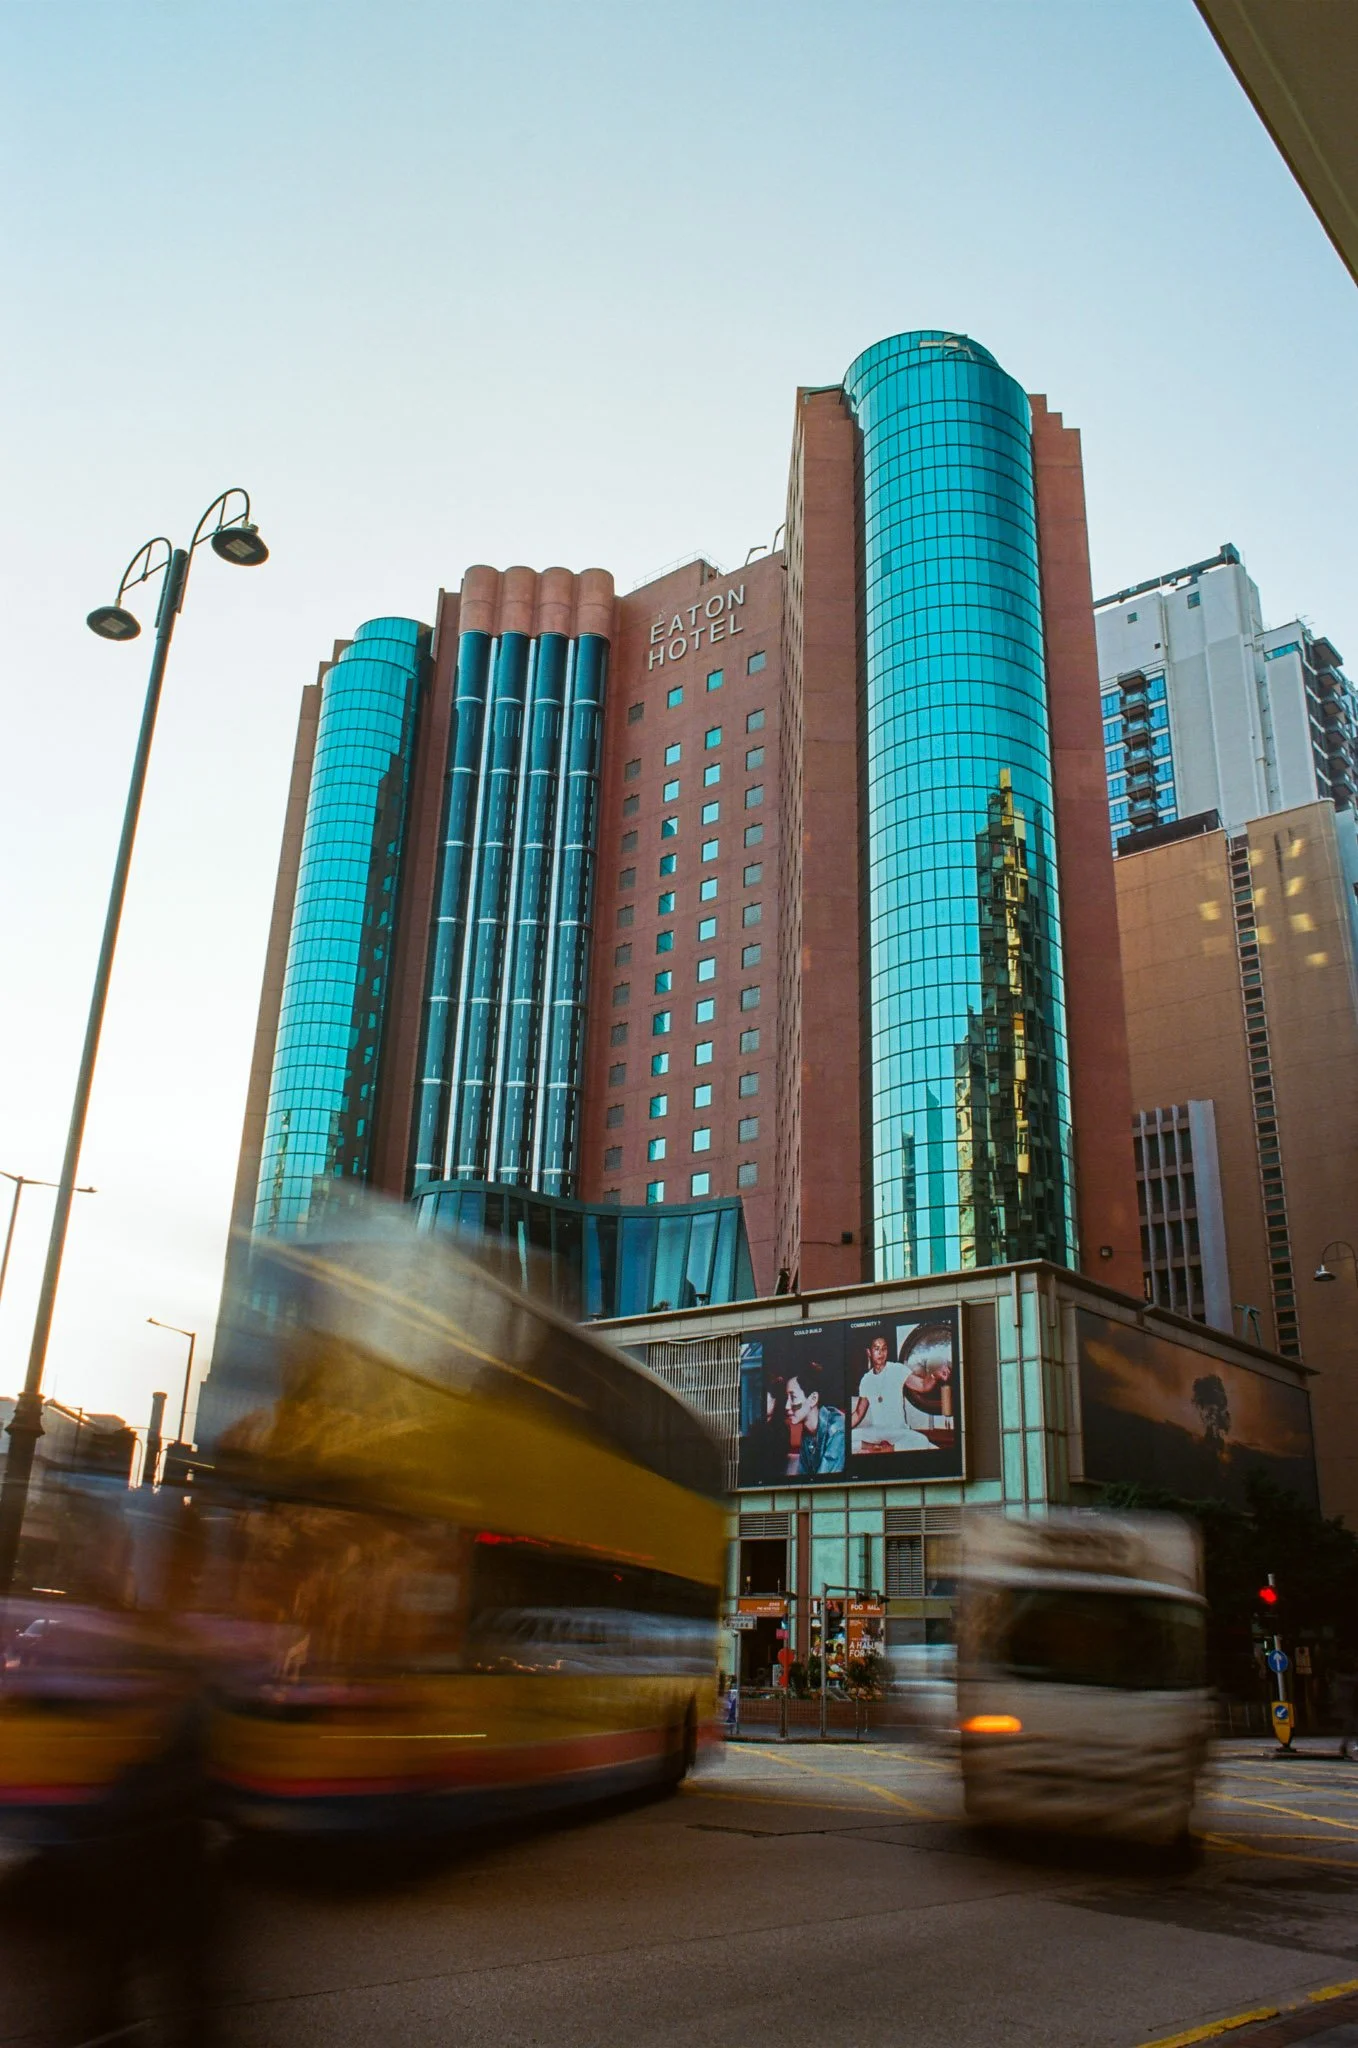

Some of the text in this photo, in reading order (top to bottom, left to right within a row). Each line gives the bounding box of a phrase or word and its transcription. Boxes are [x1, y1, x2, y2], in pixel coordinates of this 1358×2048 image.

[650, 584, 745, 645] EATON
[648, 614, 744, 671] HOTEL
[850, 1321, 877, 1329] COMMUNITY
[849, 1649, 865, 1658] FOR
